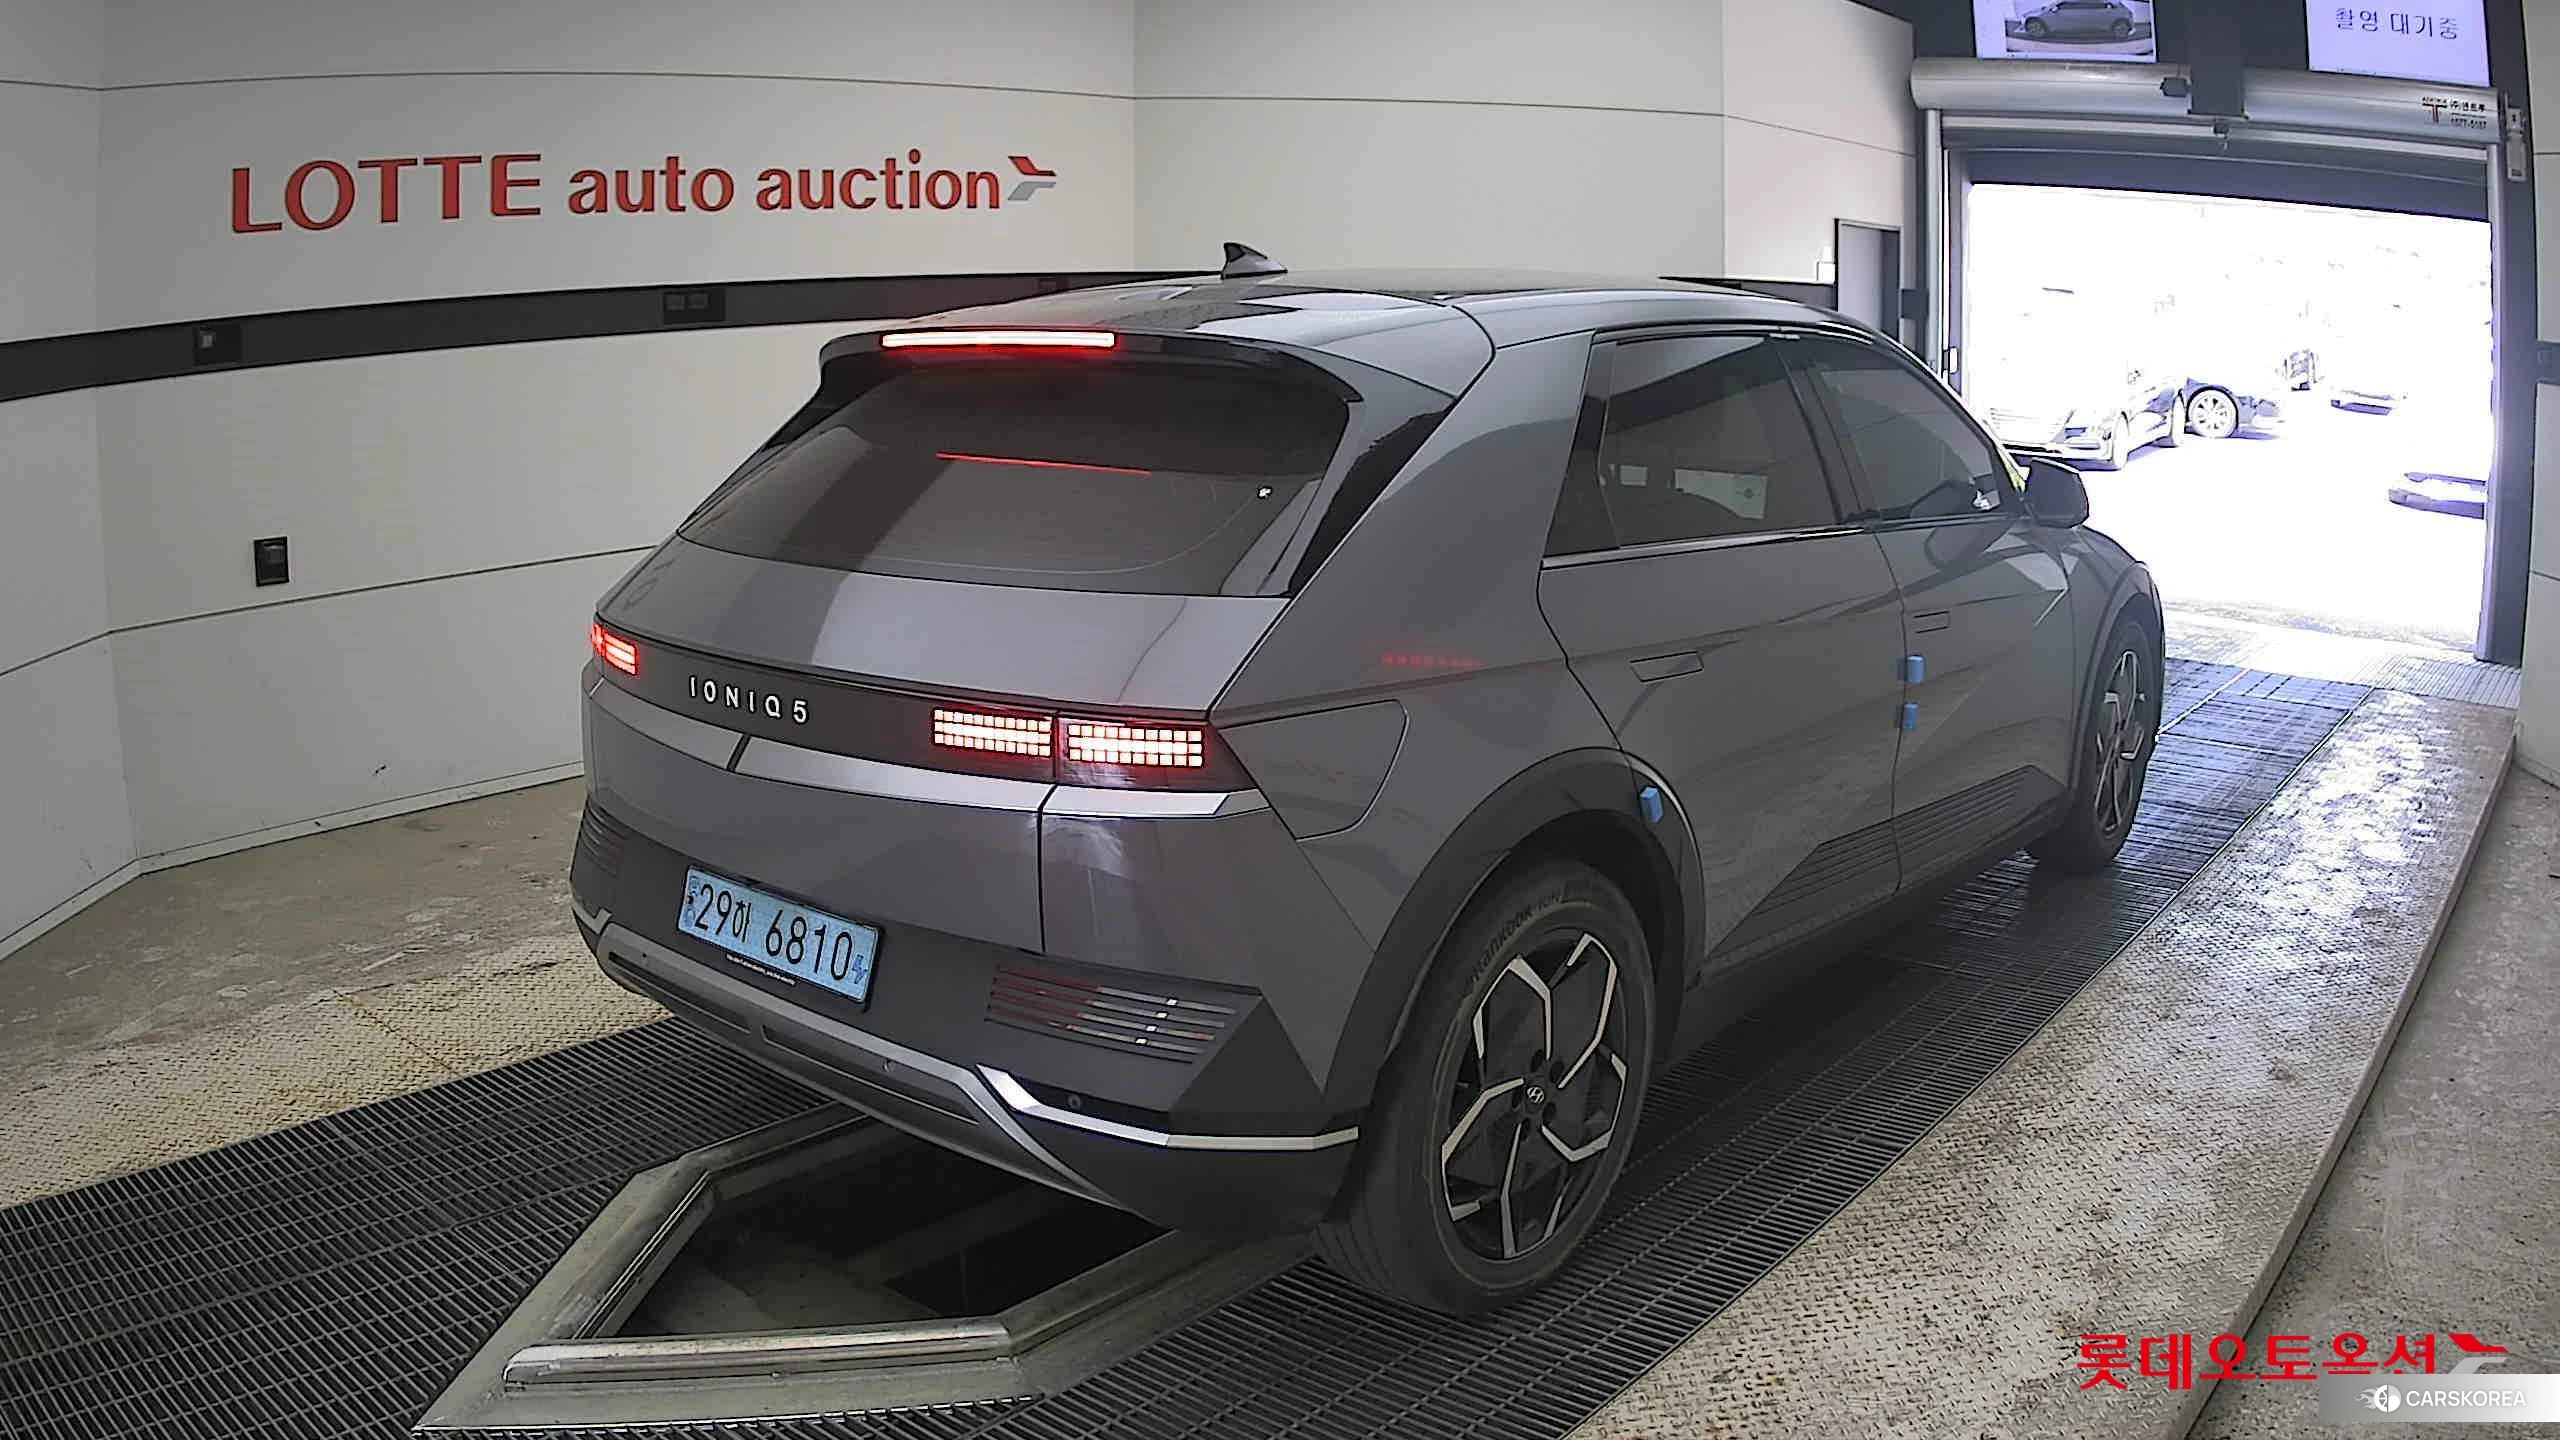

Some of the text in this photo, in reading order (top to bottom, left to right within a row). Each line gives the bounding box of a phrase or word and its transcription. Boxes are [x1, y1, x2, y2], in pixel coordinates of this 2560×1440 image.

[2336, 7, 2379, 32] 촬영
[231, 148, 1001, 234] LOTTE auto auction
[690, 676, 807, 724] IONIQ 5
[694, 883, 752, 943] 29하
[765, 908, 854, 981] 6810
